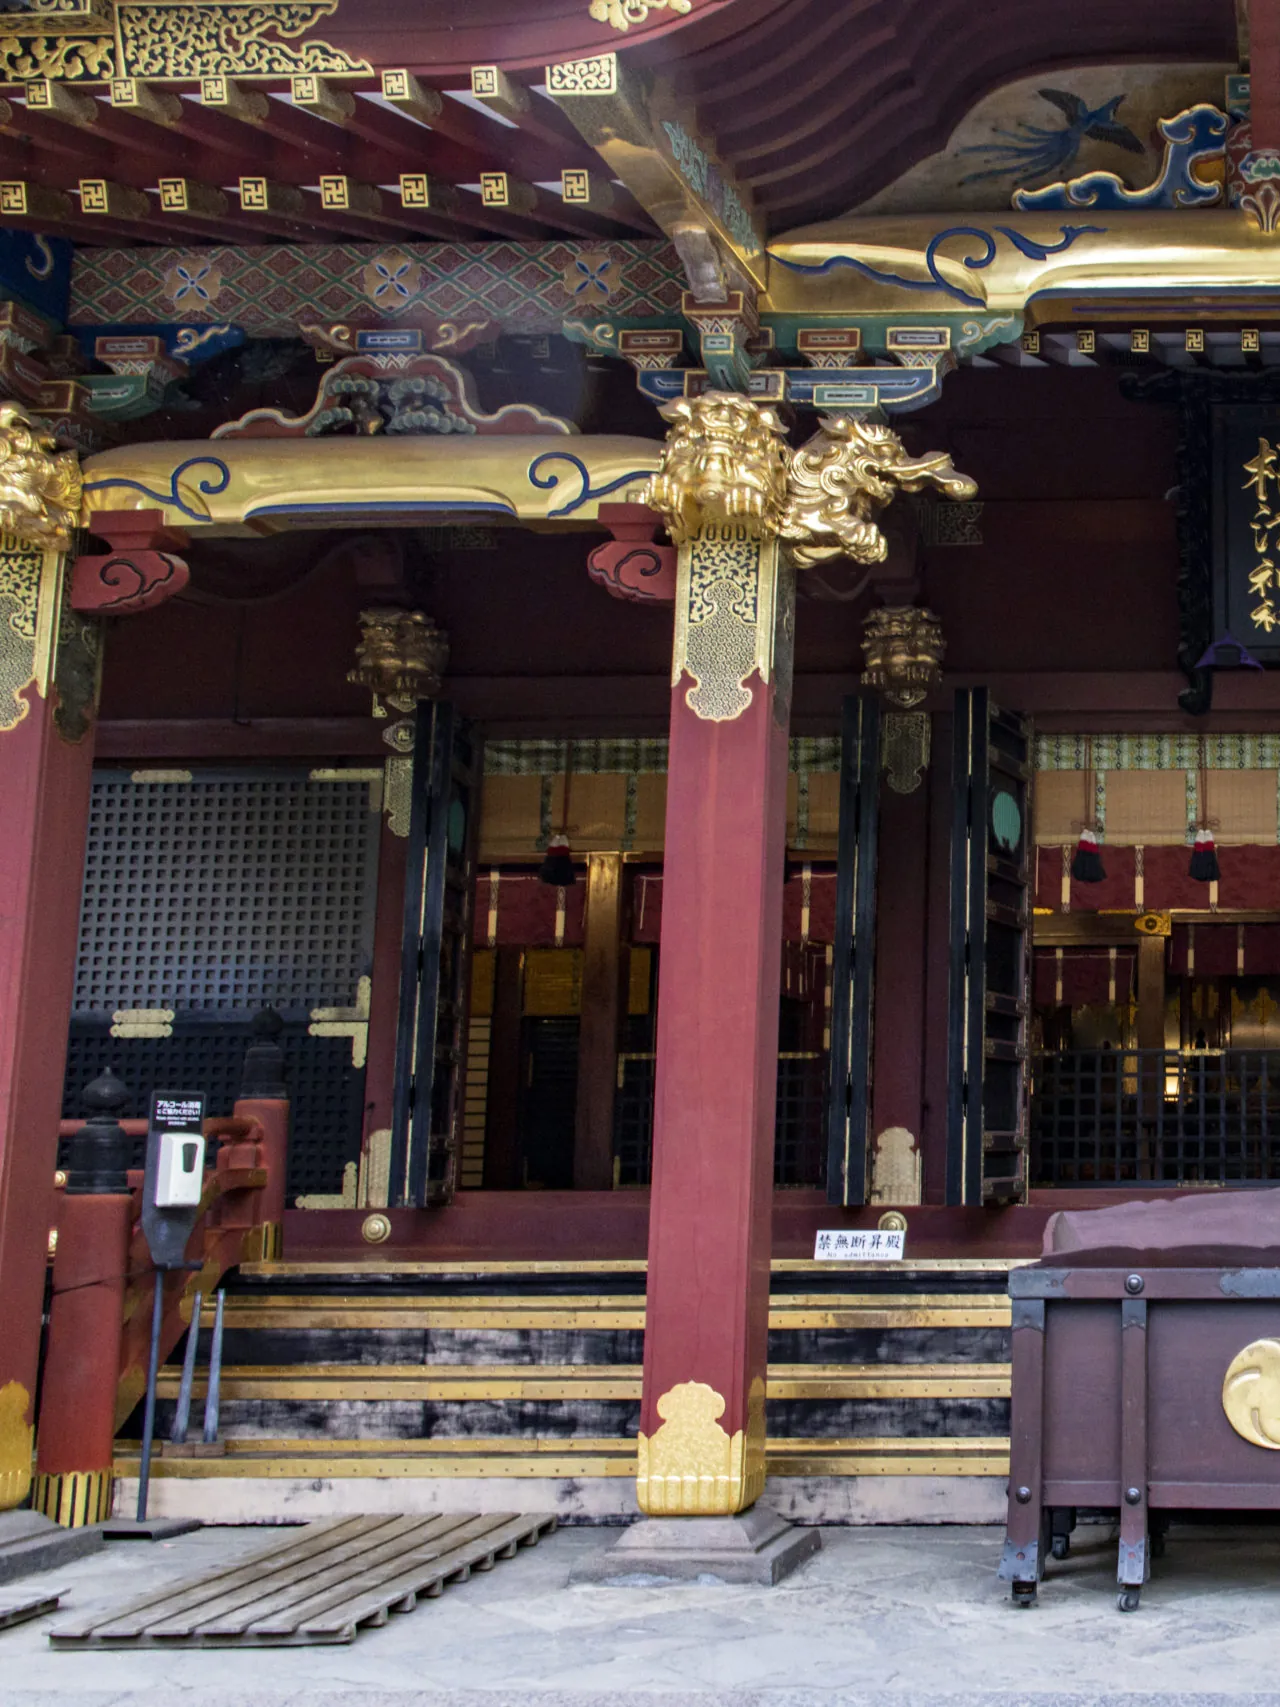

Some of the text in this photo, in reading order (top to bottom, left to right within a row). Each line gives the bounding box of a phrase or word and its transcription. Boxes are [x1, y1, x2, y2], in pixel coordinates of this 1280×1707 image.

[818, 1234, 901, 1250] 禁無断昇殿
